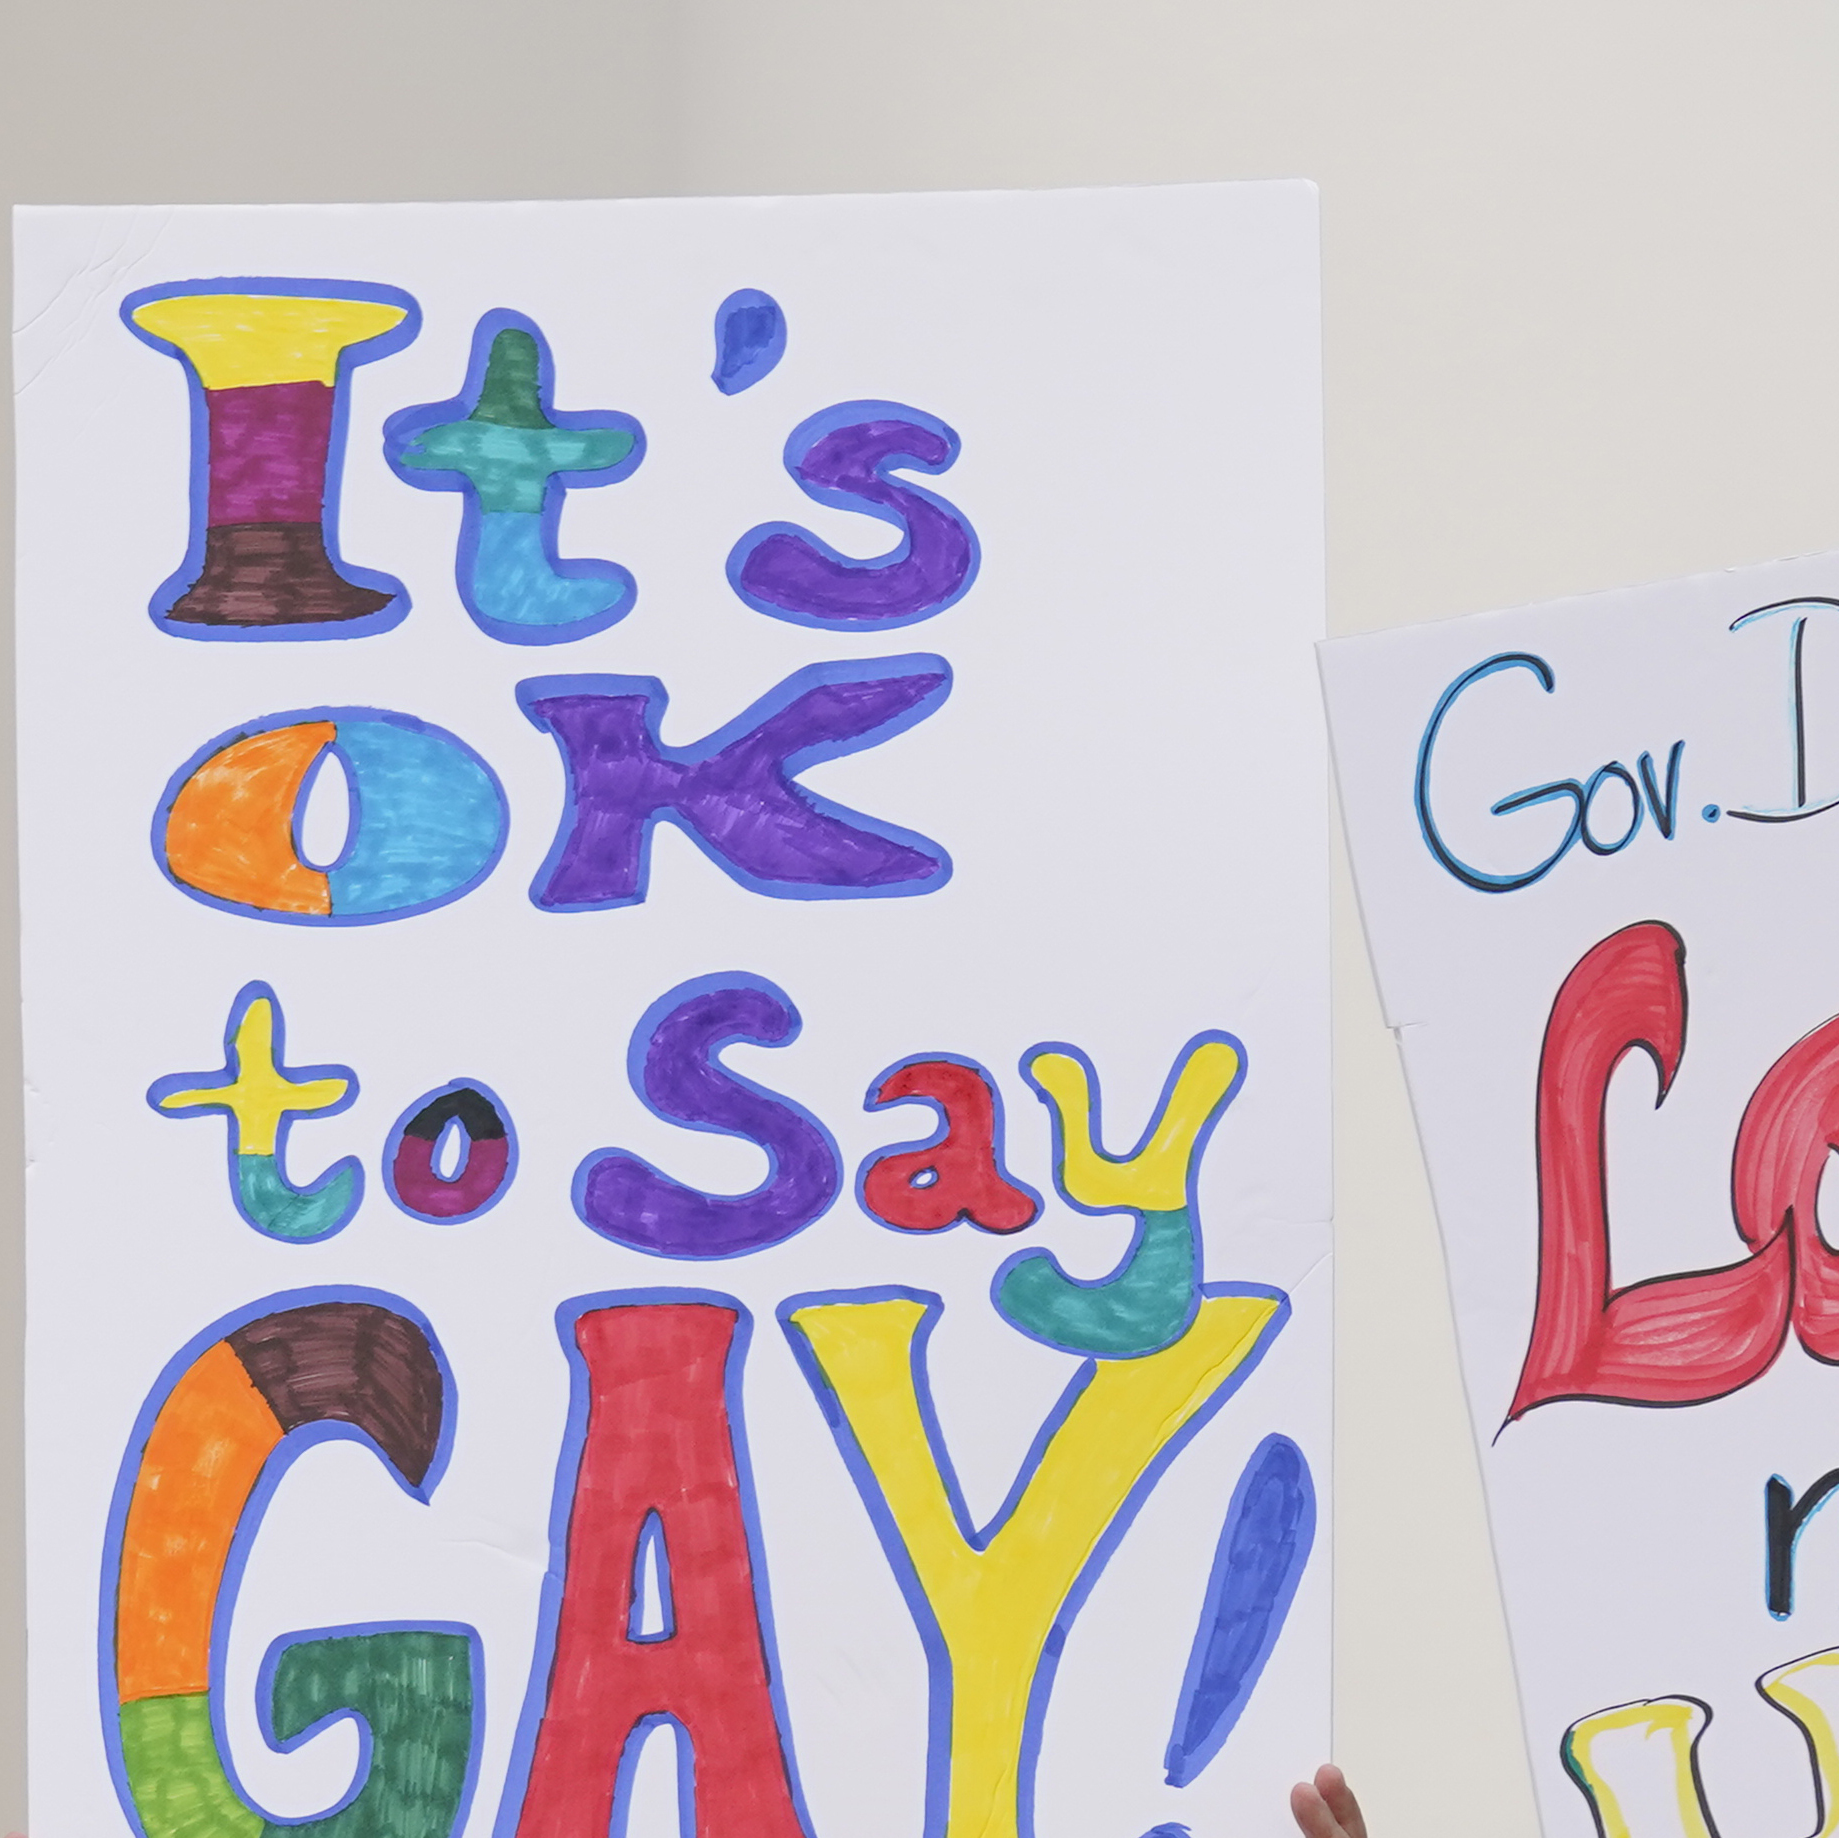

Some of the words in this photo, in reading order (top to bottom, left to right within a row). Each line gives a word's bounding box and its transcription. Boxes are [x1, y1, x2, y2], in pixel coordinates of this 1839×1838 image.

[118, 277, 981, 646] It's
[150, 652, 954, 926] OK
[1415, 651, 1721, 894] Gov.
[145, 980, 518, 1245] to
[571, 970, 1248, 1358] Say
